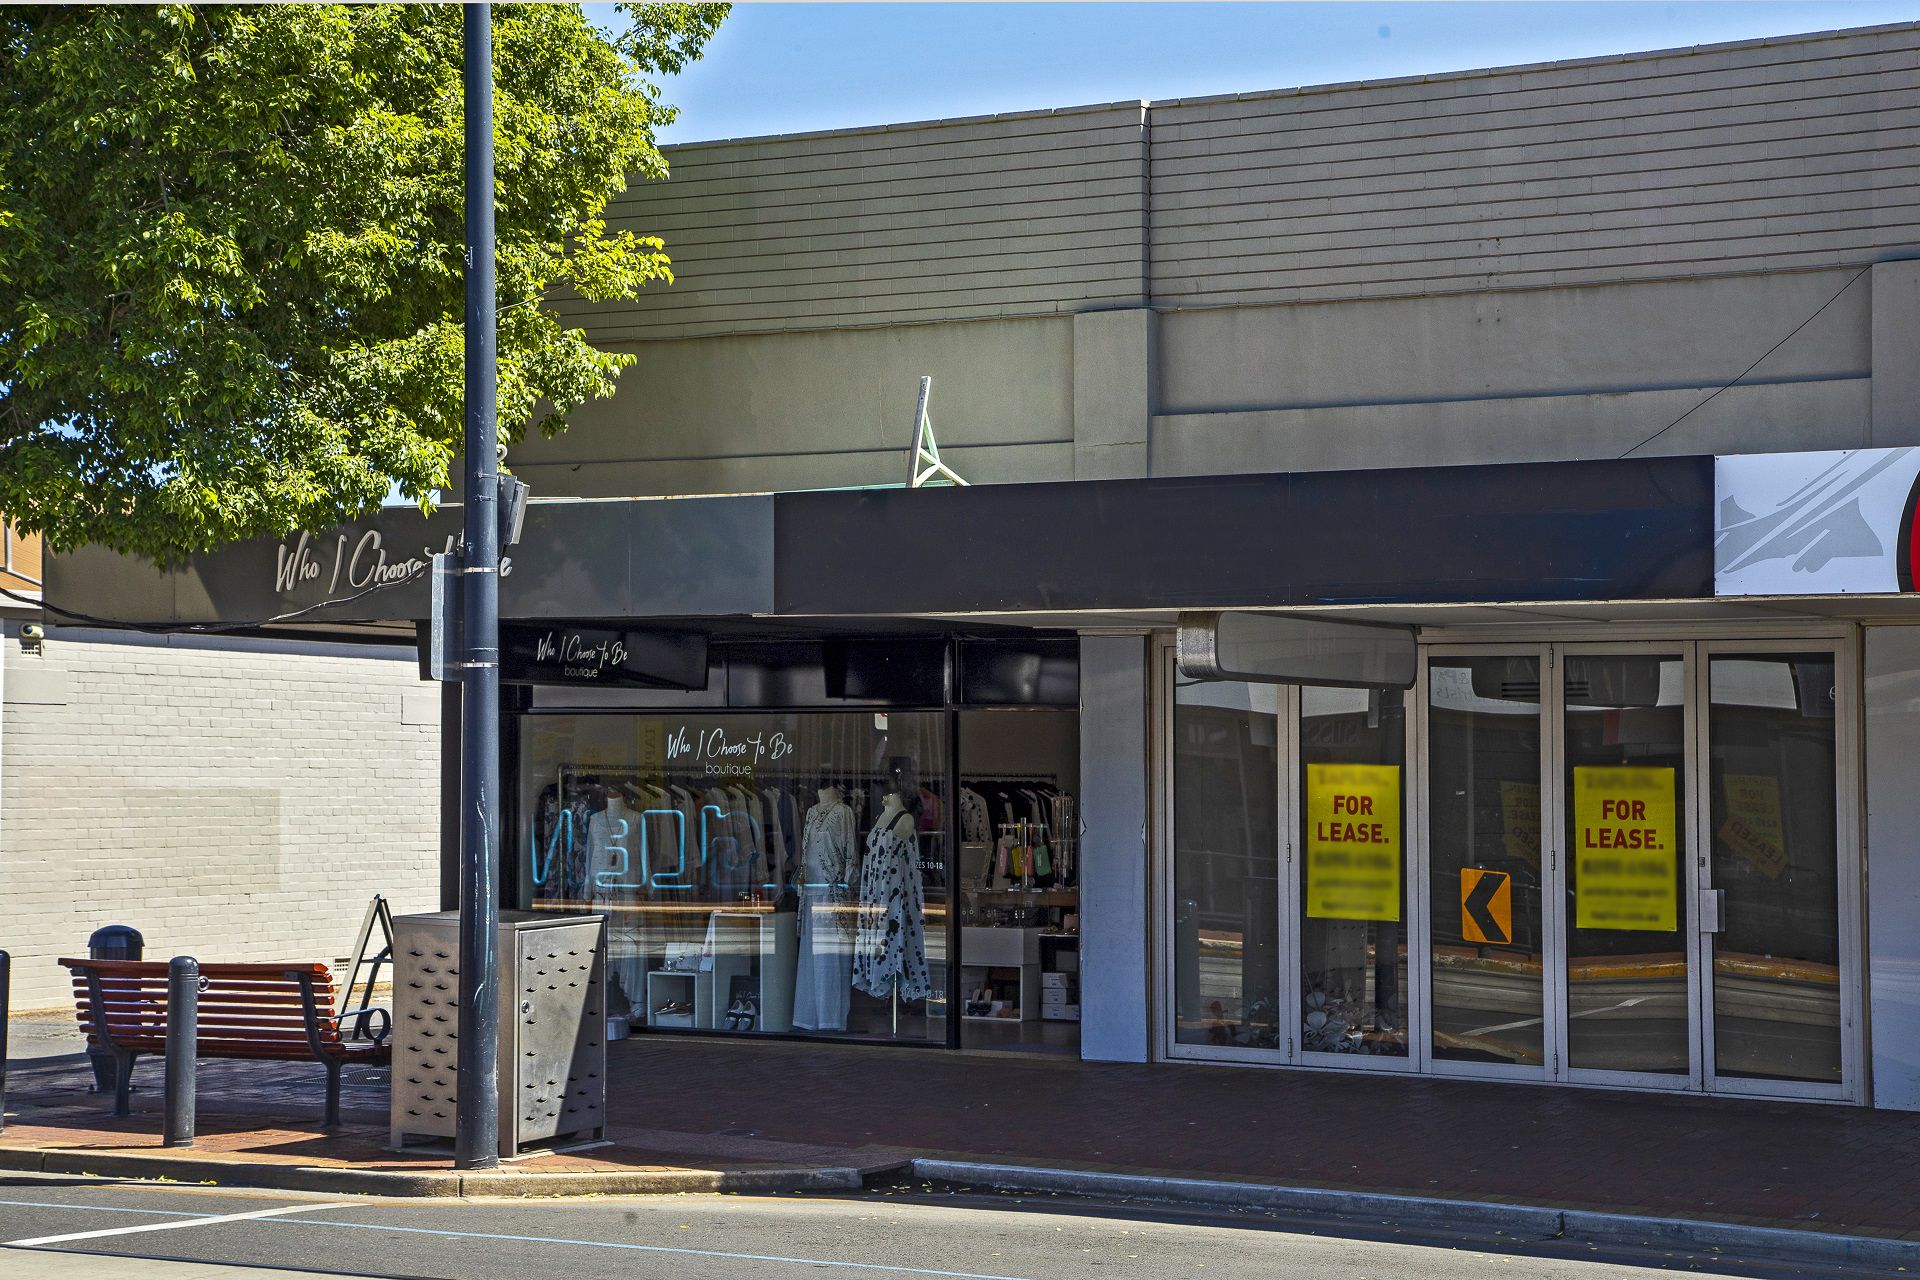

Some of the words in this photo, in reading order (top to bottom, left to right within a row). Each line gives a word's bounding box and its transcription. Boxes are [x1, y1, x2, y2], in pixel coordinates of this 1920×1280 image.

[276, 530, 320, 592] Who
[349, 530, 424, 588] Choose
[536, 631, 556, 661] Who
[567, 634, 596, 662] Choose
[612, 641, 628, 665] Be
[564, 665, 598, 678] boutique
[667, 726, 691, 759] Who
[707, 728, 747, 758] Choose
[769, 732, 793, 760] Be
[705, 762, 752, 776] boutique
[1333, 795, 1373, 815] FOR
[1602, 799, 1646, 820] FOR
[1317, 822, 1389, 844] LEASE.
[1585, 828, 1664, 850] LEASE.
[927, 861, 944, 870] 10-18
